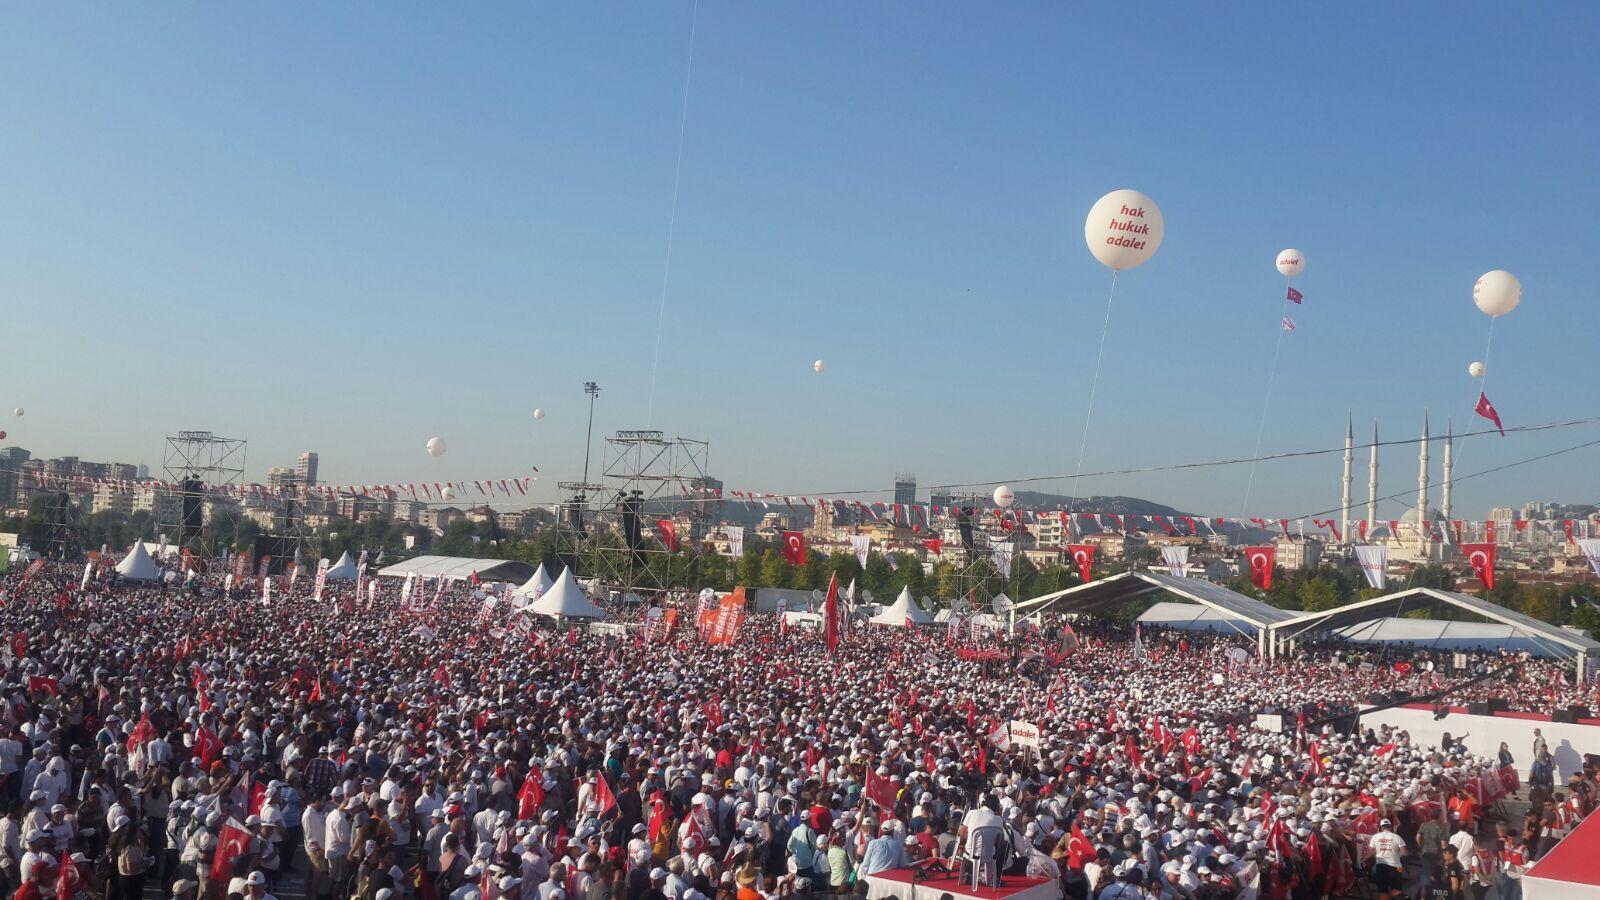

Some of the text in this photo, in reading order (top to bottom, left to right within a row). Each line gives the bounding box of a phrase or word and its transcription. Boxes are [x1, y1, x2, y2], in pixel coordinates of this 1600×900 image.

[1120, 205, 1145, 218] hak
[1109, 218, 1150, 235] hukuk
[1106, 236, 1146, 250] adalet
[1012, 728, 1036, 740] adalet
